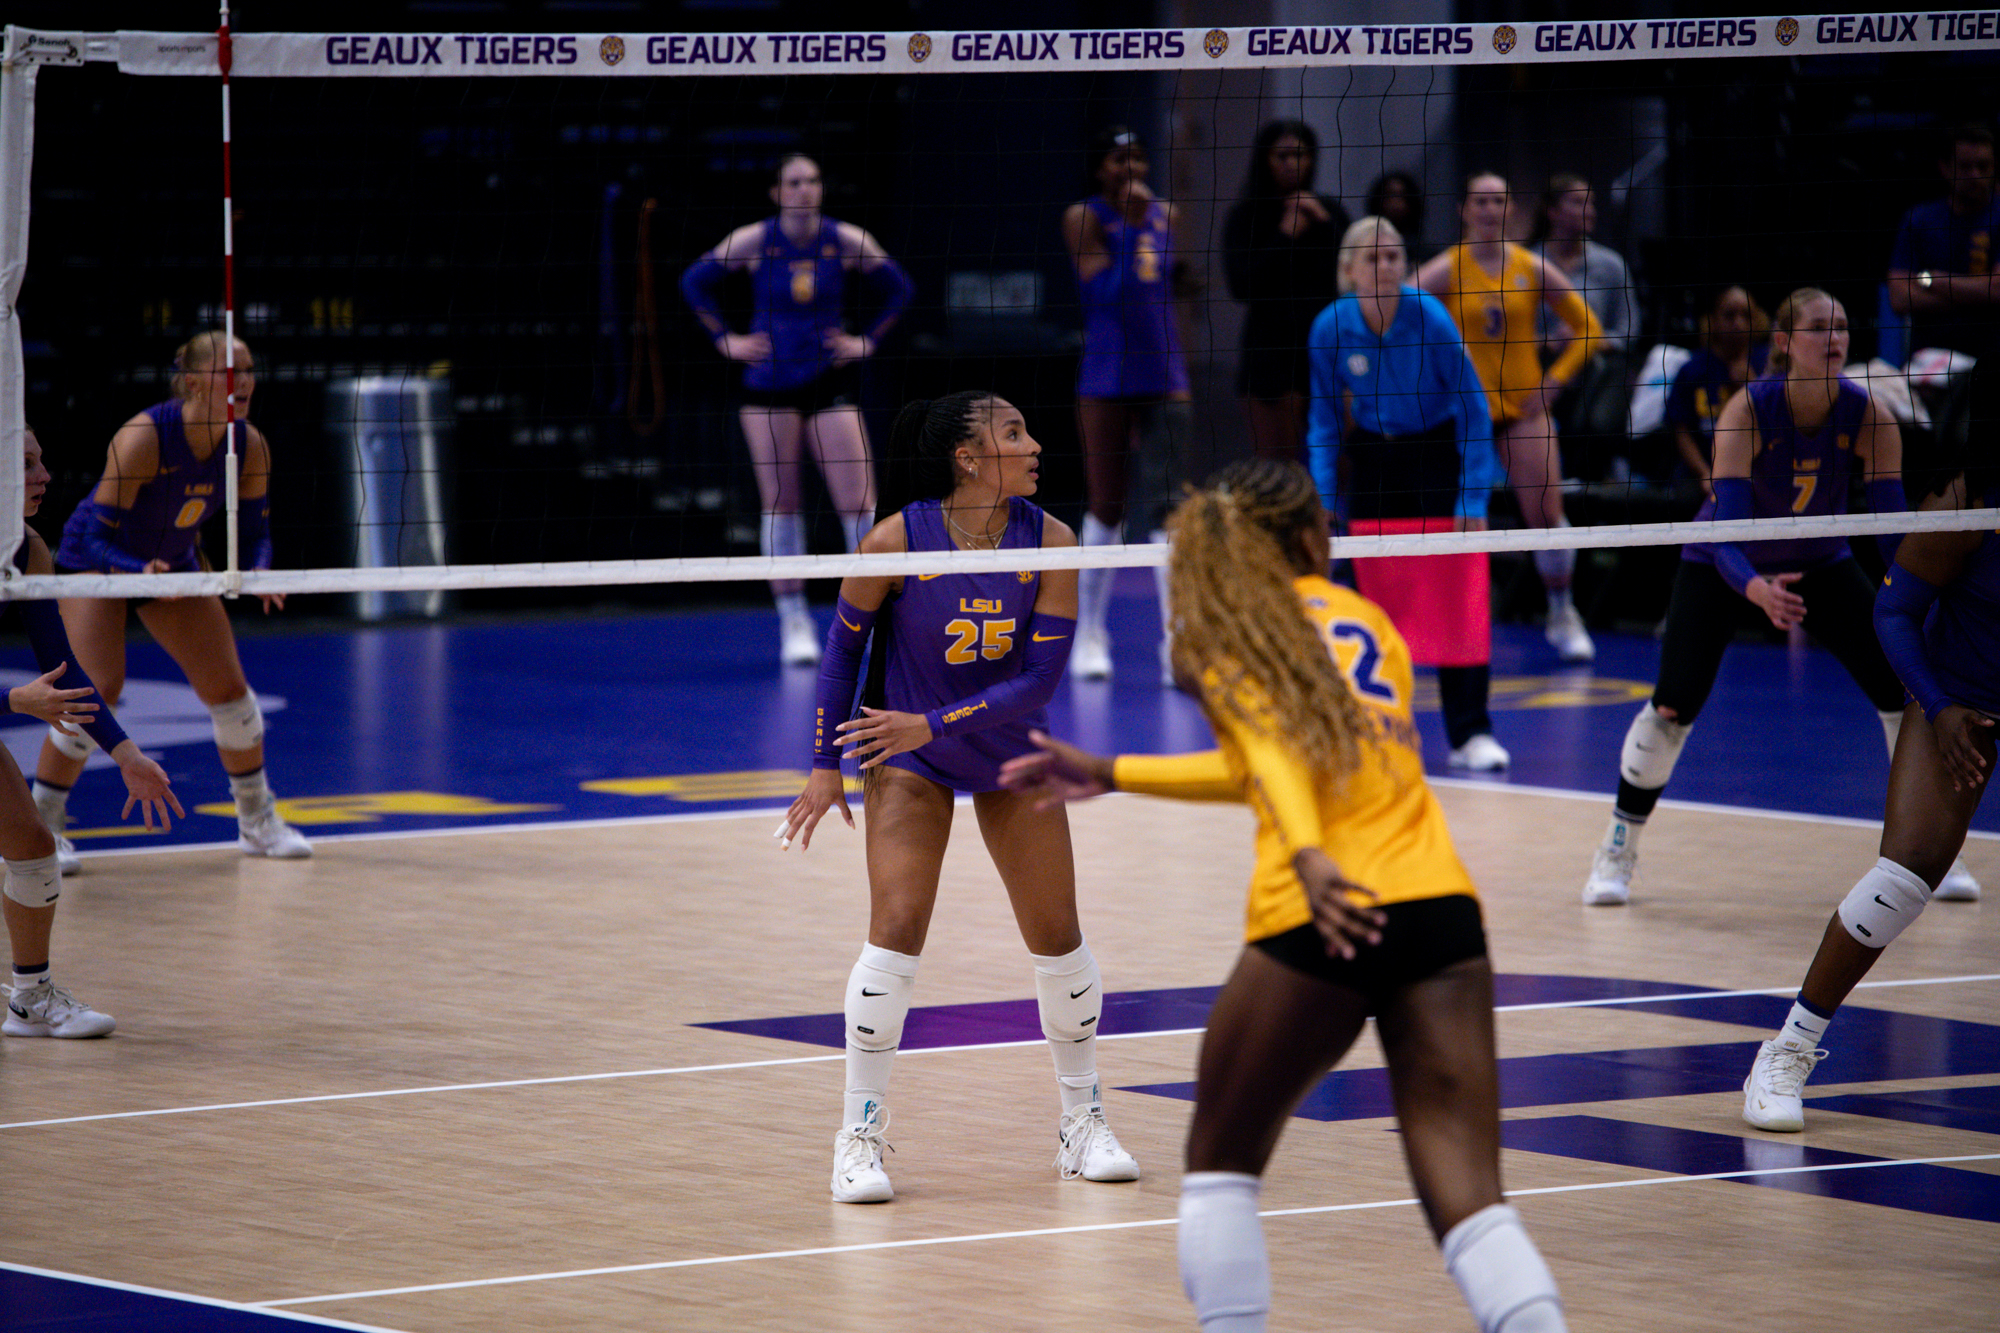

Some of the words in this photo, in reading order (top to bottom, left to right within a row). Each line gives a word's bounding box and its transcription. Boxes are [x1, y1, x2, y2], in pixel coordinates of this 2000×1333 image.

[1247, 27, 1352, 56] GEAUX
[1362, 25, 1473, 55] TIGERS
[1535, 22, 1638, 52] GEAUX
[1646, 19, 1758, 49] TIGERS
[1816, 14, 1919, 43] GEAUX
[1927, 12, 2000, 40] TIGE
[326, 36, 442, 66] GEAUX
[455, 36, 577, 65] TIGERS
[647, 35, 757, 65] GEAUX
[767, 34, 886, 63] TIGERS
[952, 32, 1059, 61] GEAUX
[1069, 30, 1184, 60] TIGERS
[1792, 473, 1818, 513] 7
[174, 497, 207, 529] 0
[960, 598, 1002, 613] LSU
[945, 618, 1016, 665] 25
[942, 700, 988, 724] TIGERS
